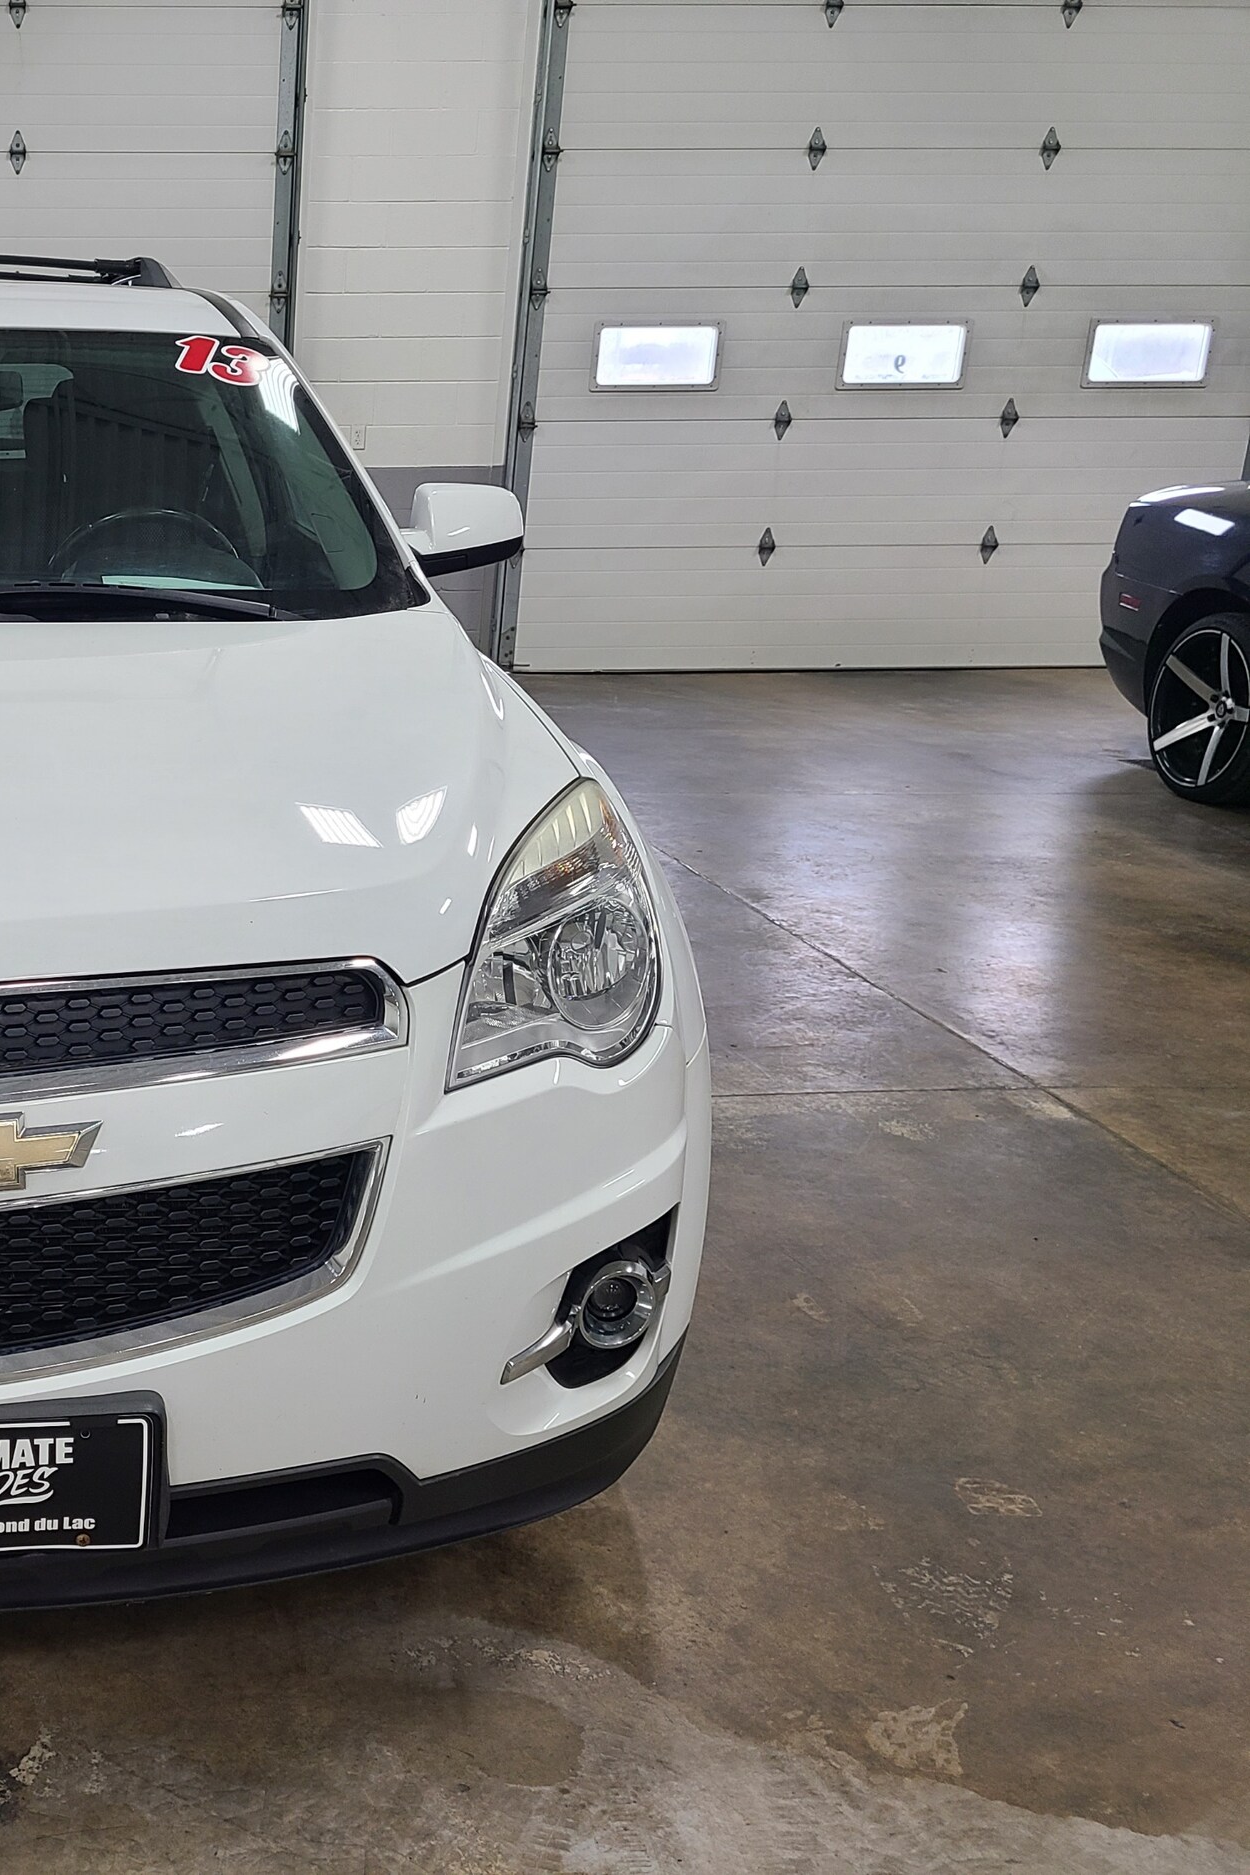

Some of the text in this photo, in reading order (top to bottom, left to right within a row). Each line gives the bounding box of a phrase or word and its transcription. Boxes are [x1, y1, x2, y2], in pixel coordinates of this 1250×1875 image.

[174, 335, 271, 386] 13
[34, 1517, 59, 1532] du
[62, 1515, 96, 1531] Lac
